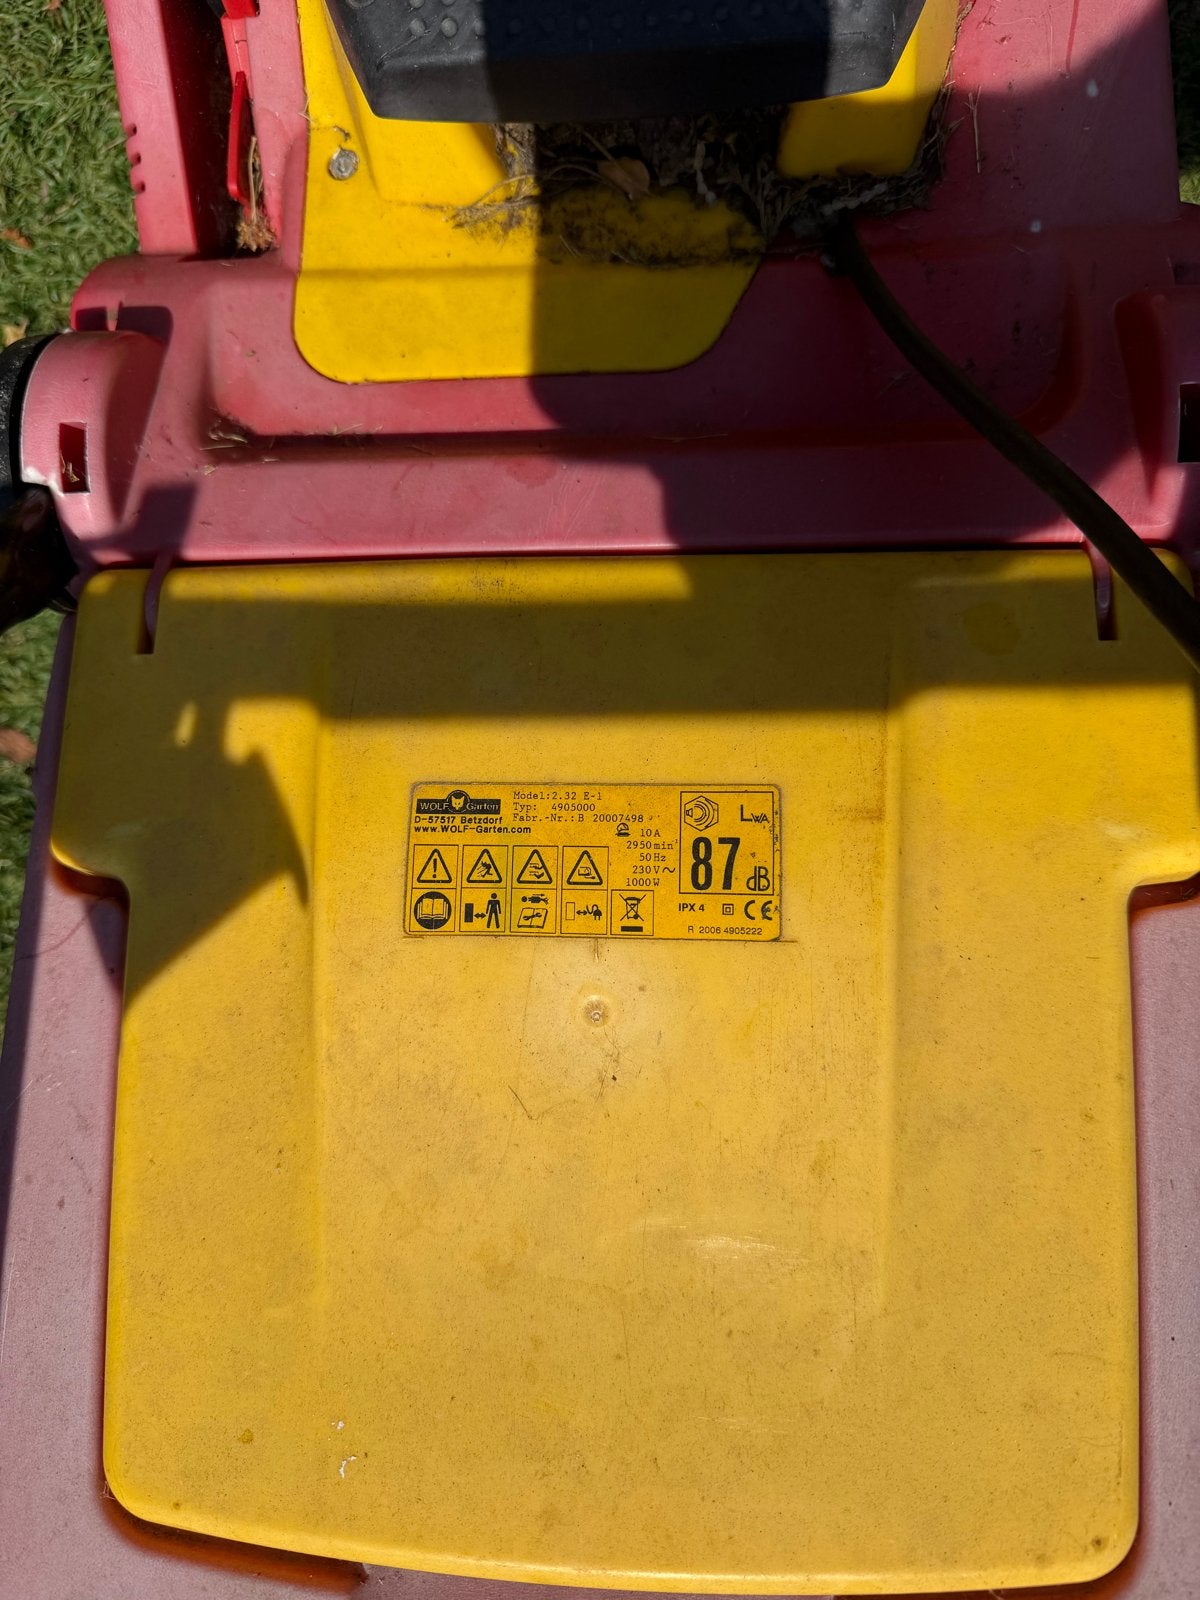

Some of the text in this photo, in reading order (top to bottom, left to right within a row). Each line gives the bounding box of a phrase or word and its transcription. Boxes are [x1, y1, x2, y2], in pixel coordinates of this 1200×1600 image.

[584, 791, 602, 800] E-1
[420, 802, 450, 810] WOLF
[513, 802, 596, 812] Typ: 4905000
[461, 816, 502, 824] Betzdorf
[593, 814, 644, 822] 20007498
[414, 826, 531, 834] www.WOLF-Garten.com
[691, 837, 740, 891] 87
[746, 866, 770, 891] dB
[678, 903, 705, 912] IPX 4
